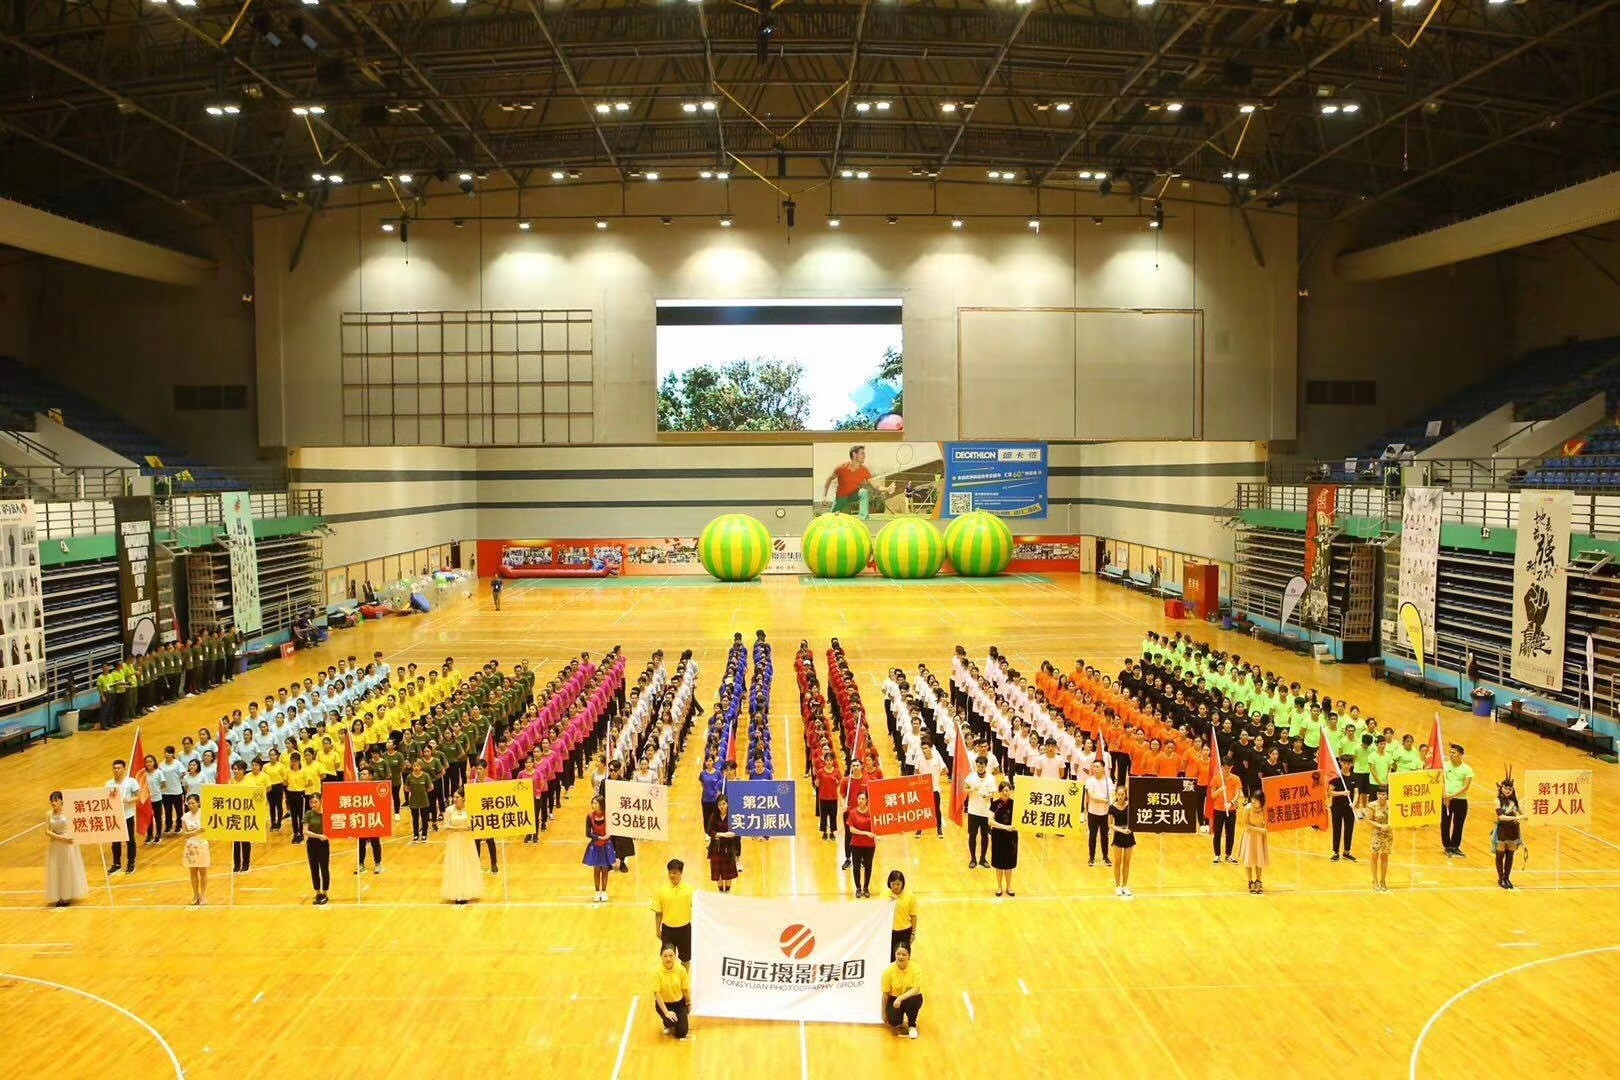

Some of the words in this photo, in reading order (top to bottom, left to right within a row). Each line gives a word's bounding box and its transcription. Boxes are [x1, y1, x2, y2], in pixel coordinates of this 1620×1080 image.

[955, 451, 996, 459] DECATHLON
[1279, 785, 1311, 801] 第7队
[1403, 784, 1431, 797] 第9队
[1538, 782, 1580, 795] 第11队
[74, 799, 113, 813] 第12队
[212, 797, 255, 811] 第10队
[338, 795, 376, 808] 第8队
[481, 795, 519, 810] 第6队
[620, 796, 654, 812] 第4队
[742, 795, 781, 809] 第2队
[884, 790, 920, 807] 第1队
[1029, 792, 1066, 807] 第3队
[1147, 792, 1183, 806] 第5队
[1395, 800, 1436, 817] 飞鹰队
[1532, 799, 1585, 815] 猎人队
[73, 816, 121, 832] 燃烧队
[208, 814, 259, 831] 小虎队
[330, 812, 385, 829] 雪豹队
[470, 811, 532, 831] 闪电侠队
[611, 812, 661, 830] 39战队
[731, 813, 793, 830] 实力派队
[873, 807, 933, 826] HIP-HOP队
[1021, 809, 1073, 828] 战狼队
[1136, 809, 1188, 825] 逆天队
[722, 956, 865, 984] 同远摄影集团
[721, 978, 768, 990] TONGYUAN
[770, 984, 834, 992] PHOTOGRAPHY
[837, 980, 865, 989] GROUP
